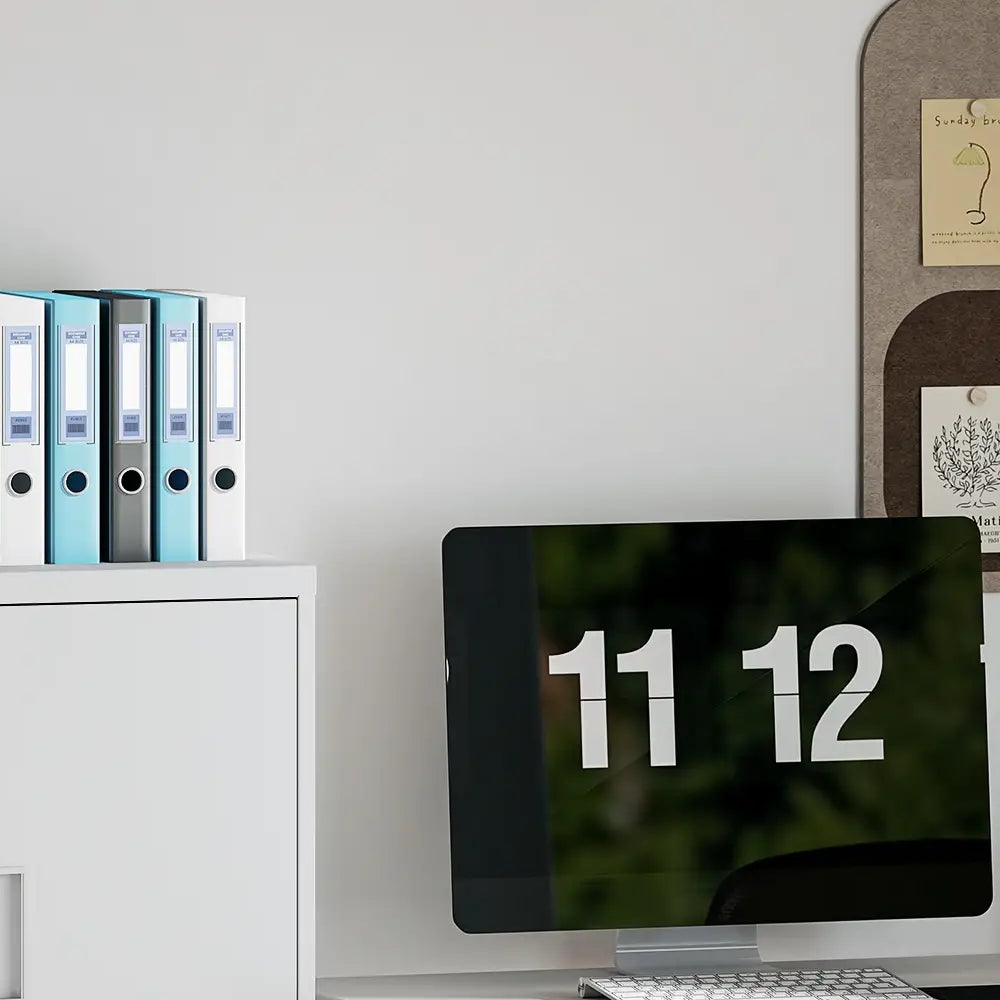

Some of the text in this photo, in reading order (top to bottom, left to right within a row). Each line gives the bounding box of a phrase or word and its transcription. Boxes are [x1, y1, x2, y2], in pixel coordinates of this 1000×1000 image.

[934, 114, 976, 128] Sunday
[548, 623, 885, 769] 11 12
